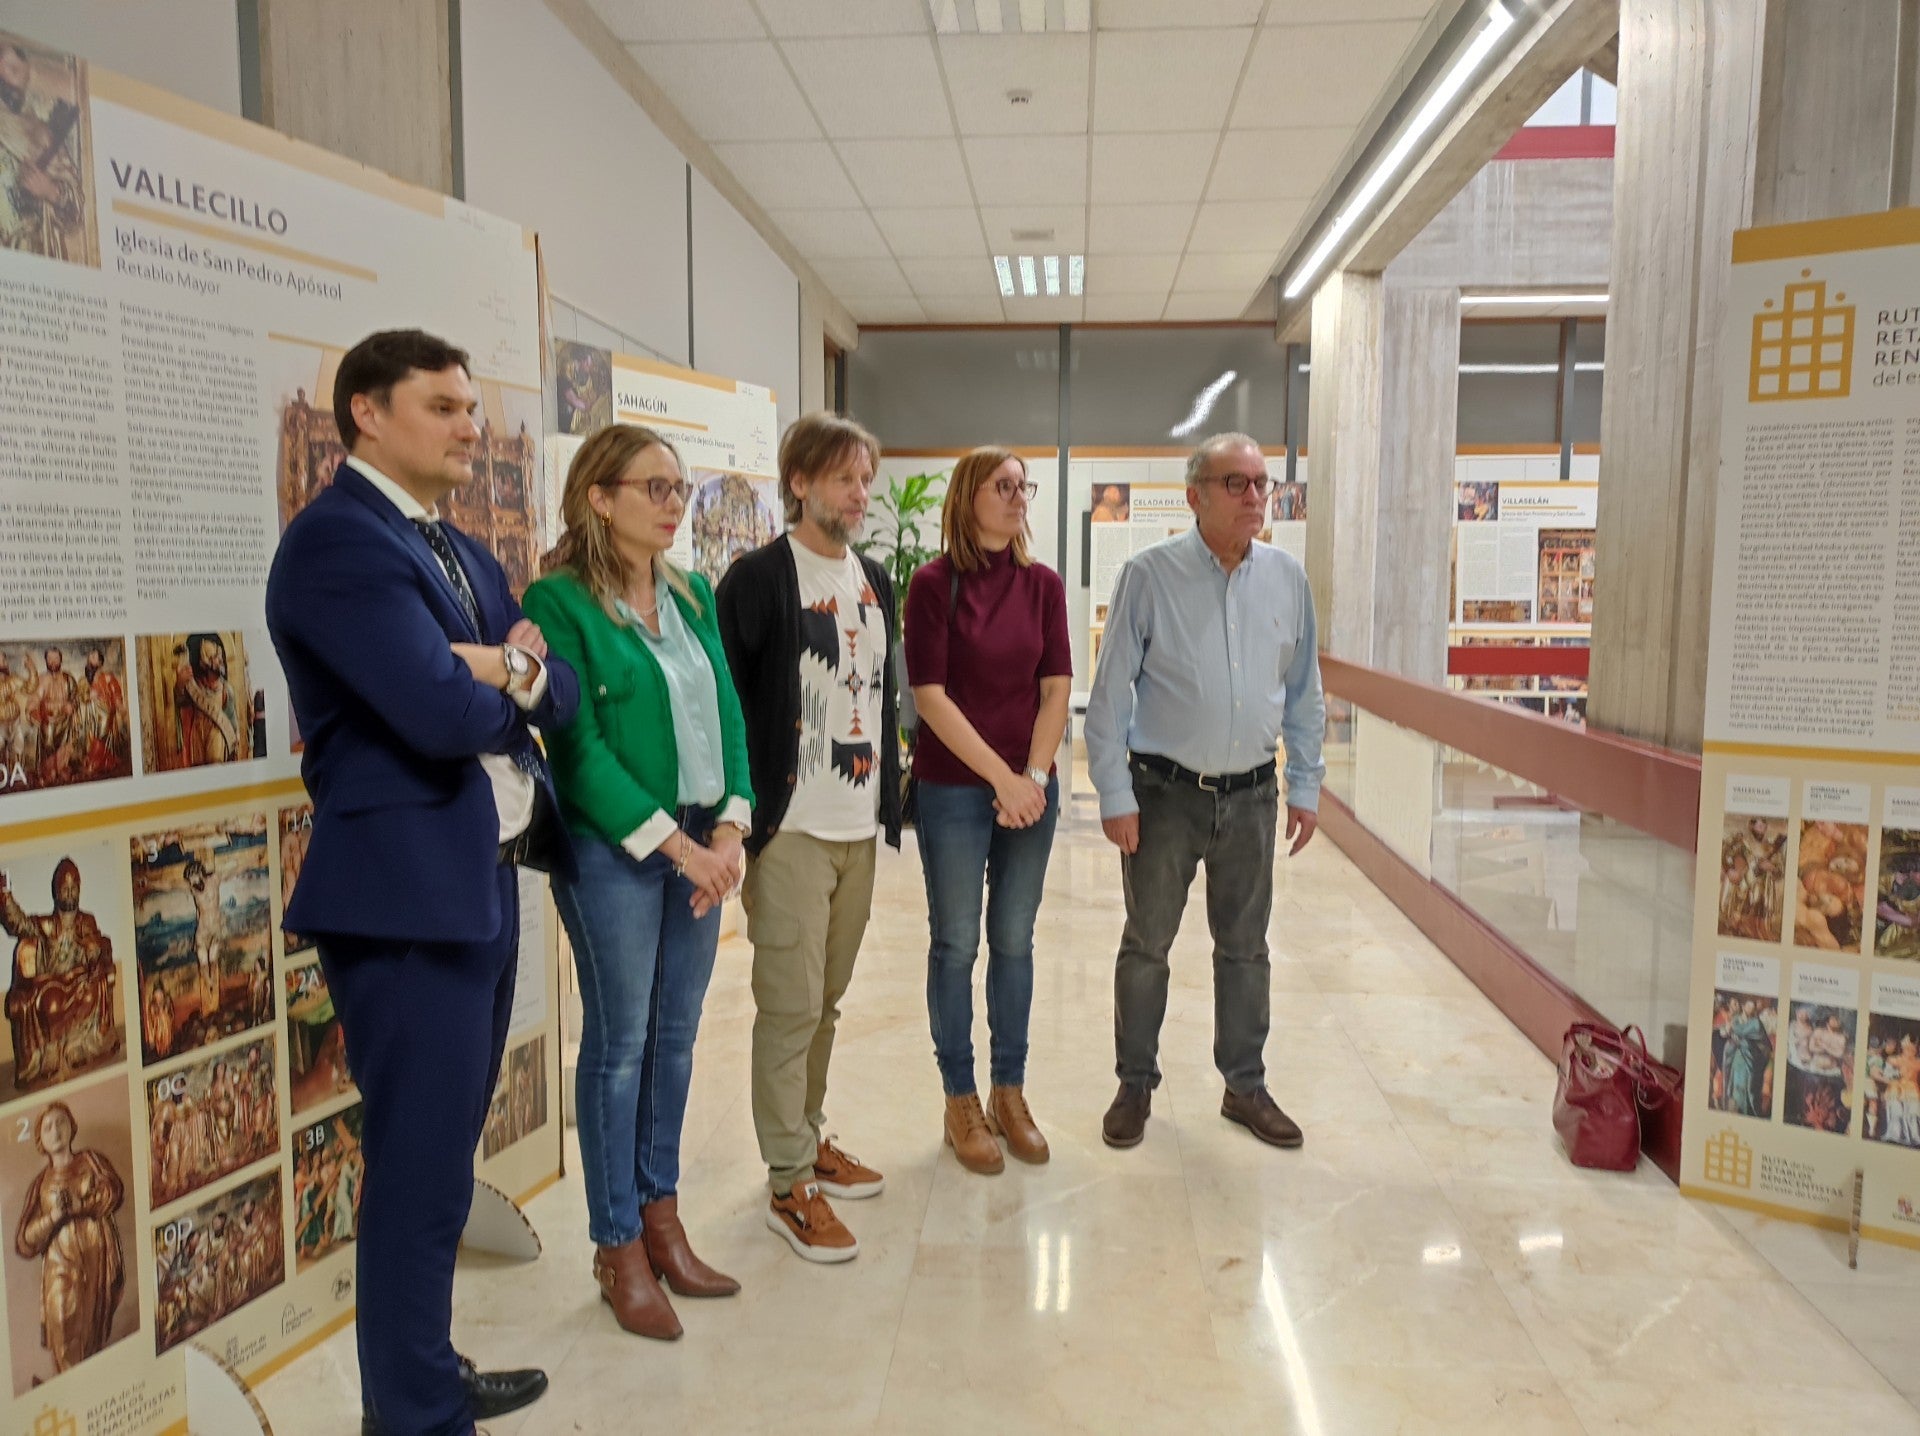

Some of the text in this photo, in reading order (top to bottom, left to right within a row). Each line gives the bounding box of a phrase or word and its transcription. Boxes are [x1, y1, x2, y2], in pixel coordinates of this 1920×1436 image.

[110, 157, 288, 235] VALLECILLO
[115, 226, 342, 301] Iglesia de San Pedro Apóstol
[117, 258, 221, 295] Retablo Mayor
[1876, 327, 1920, 347] RET
[1874, 348, 1920, 367] REN
[1873, 368, 1901, 388] del
[617, 392, 668, 414] SAHAGÚN
[1502, 496, 1549, 505] VILLASELÁN
[147, 840, 158, 863] 3
[299, 972, 319, 994] 2A
[16, 1118, 31, 1142] 2
[305, 1125, 325, 1150] 3B
[1761, 1173, 1843, 1198] RENACENTISTAS
[87, 1396, 117, 1420] RUTA
[87, 1392, 143, 1433] RETABLOS
